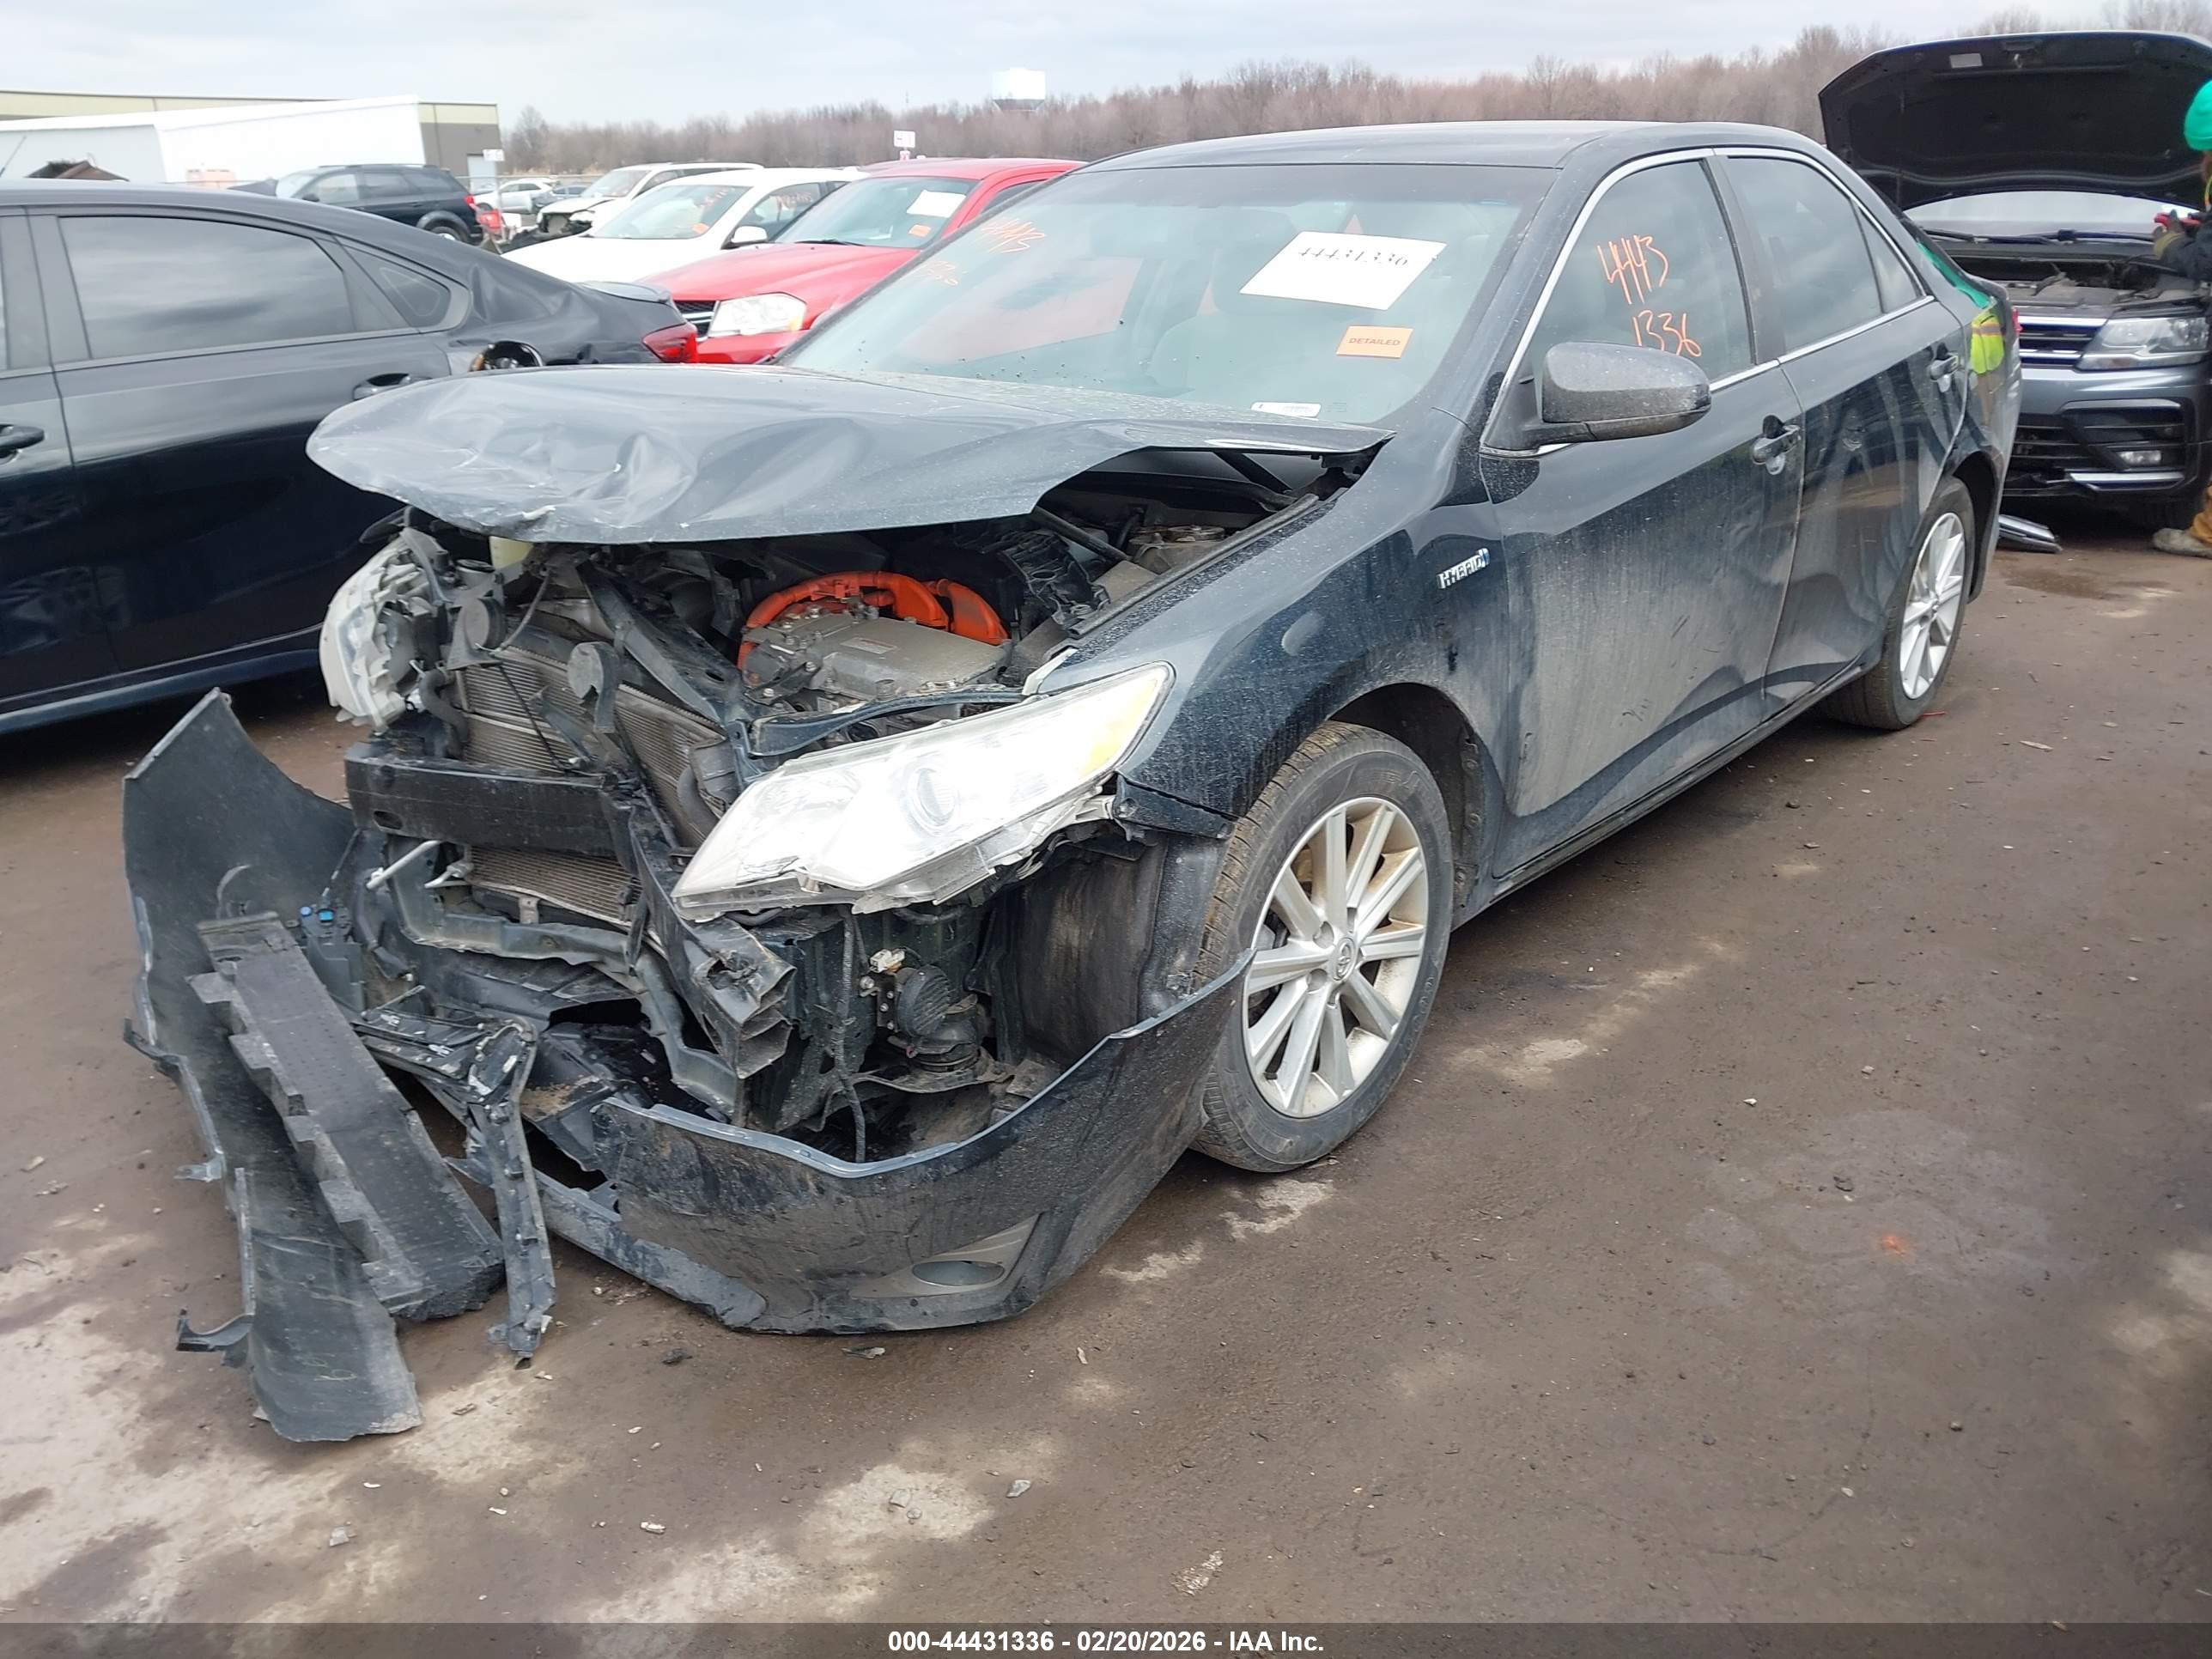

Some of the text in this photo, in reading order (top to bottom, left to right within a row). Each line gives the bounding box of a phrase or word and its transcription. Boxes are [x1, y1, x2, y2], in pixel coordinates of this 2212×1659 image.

[1596, 234, 1669, 304] 4443
[1348, 337, 1401, 346] DETAILED
[1632, 309, 1702, 357] 1336
[1437, 553, 1486, 589] HYBRID
